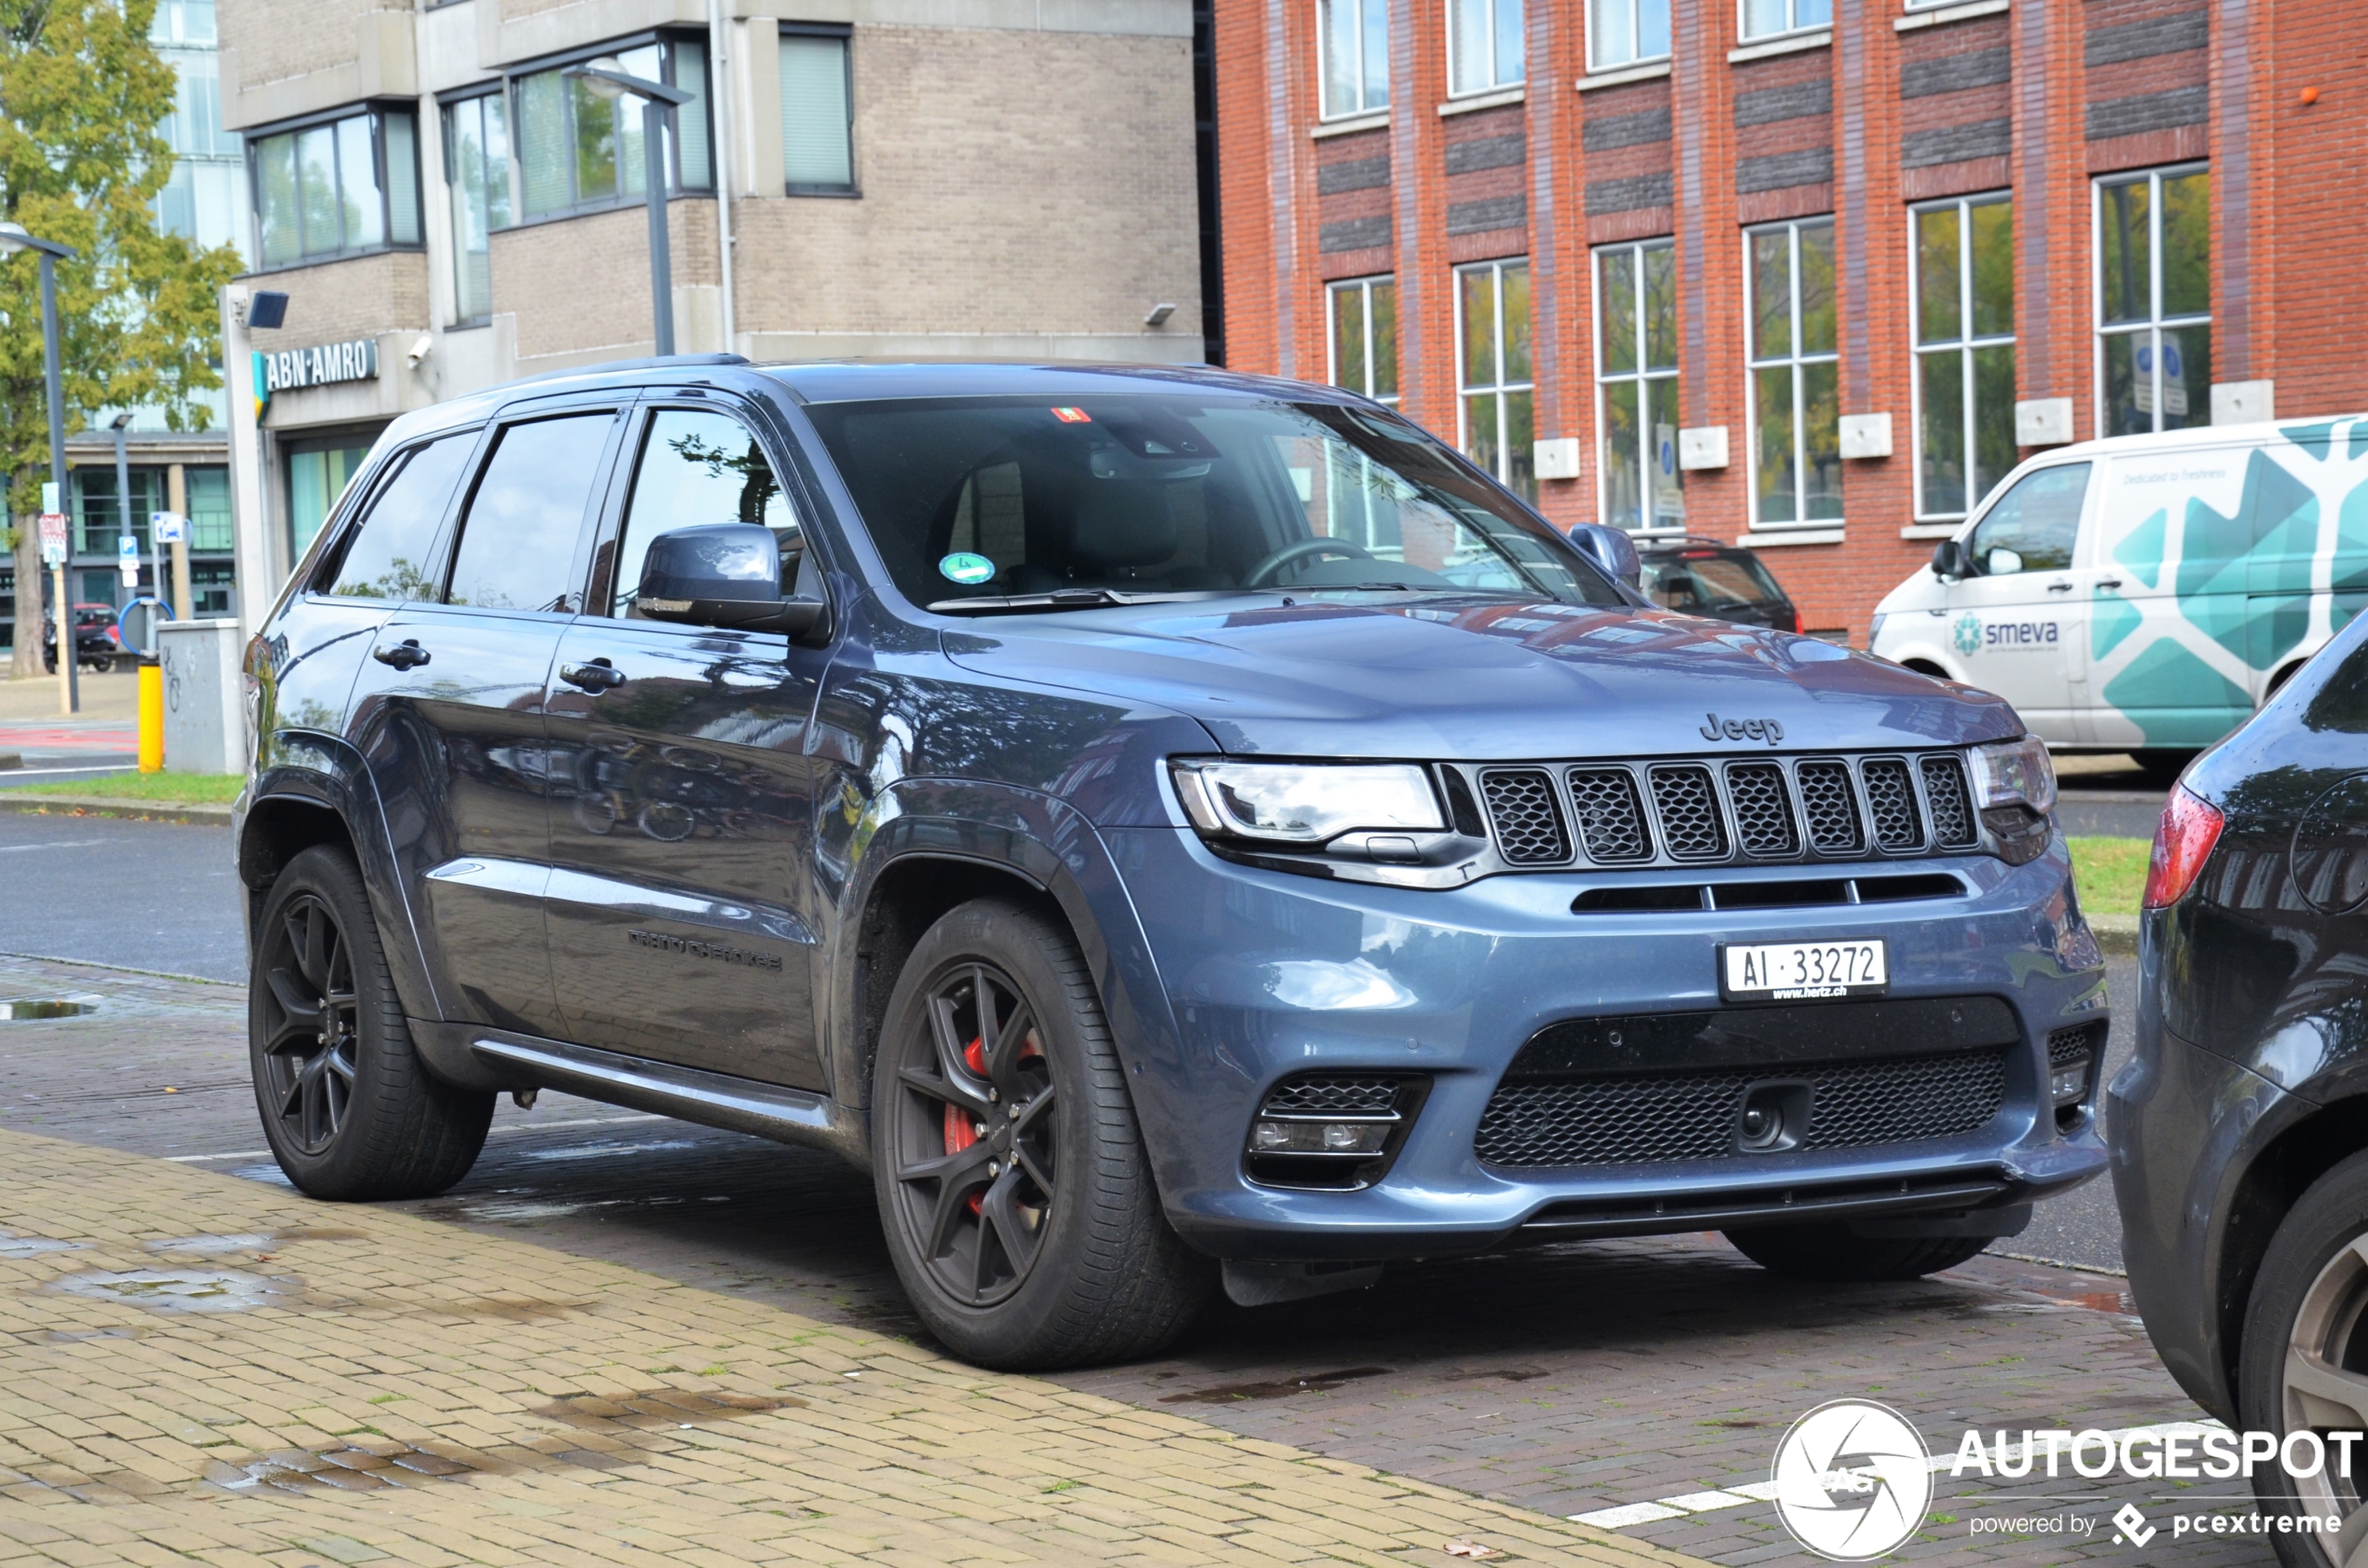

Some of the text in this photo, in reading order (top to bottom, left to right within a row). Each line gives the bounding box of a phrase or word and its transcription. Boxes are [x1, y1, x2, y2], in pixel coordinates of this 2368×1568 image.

[1986, 621, 2058, 644] smeva
[1700, 713, 1784, 746] Jeep
[1793, 945, 1875, 984] 33272
[1772, 985, 1848, 999] www.hertz.ch
